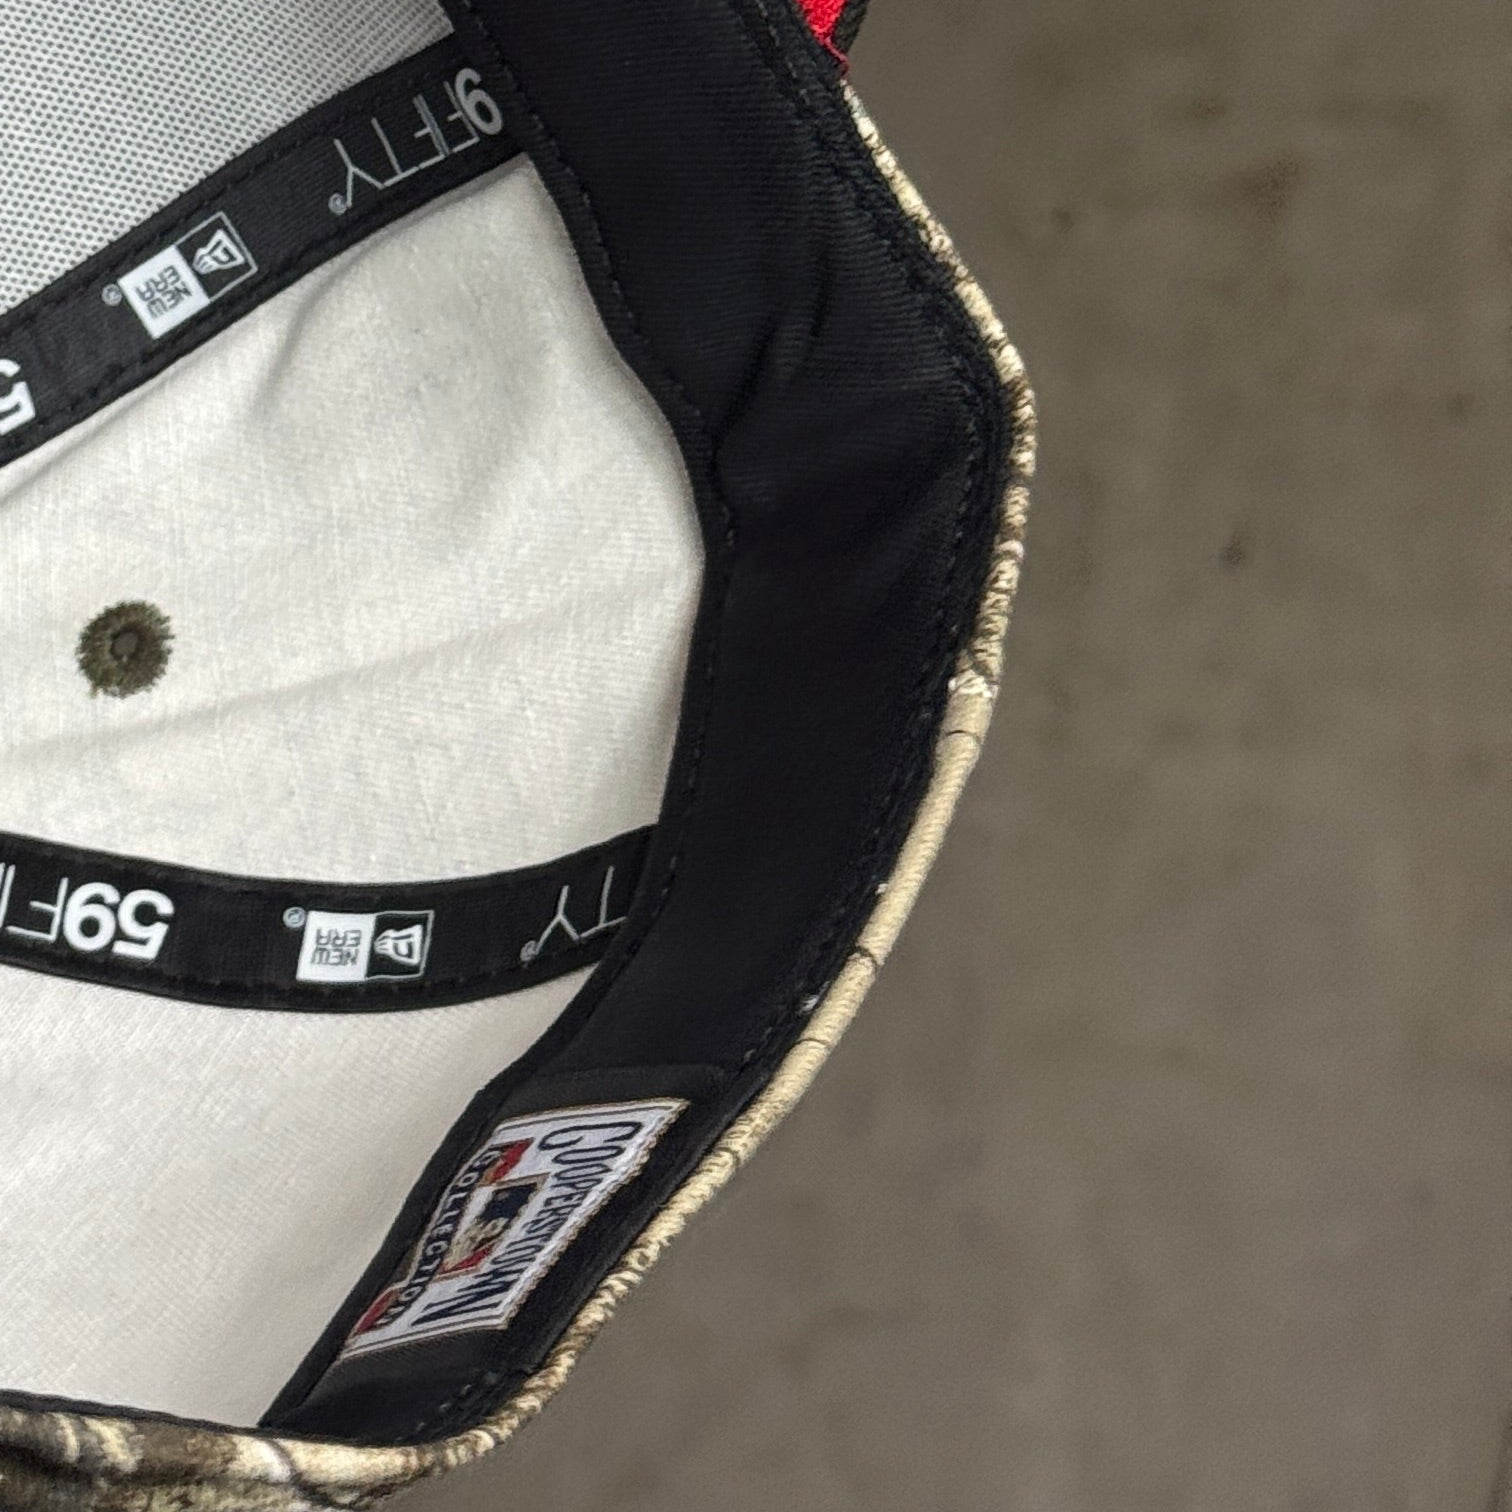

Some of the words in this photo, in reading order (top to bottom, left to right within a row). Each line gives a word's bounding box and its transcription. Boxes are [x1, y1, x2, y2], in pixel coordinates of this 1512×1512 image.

[333, 67, 504, 209] 9FIFTY
[135, 264, 181, 302] ERA
[145, 280, 193, 319] NEW
[310, 946, 360, 967] NEW
[315, 928, 362, 948] ERA
[375, 1146, 504, 1328] COLLECTION
[408, 1120, 644, 1328] COOPERSTOWN
